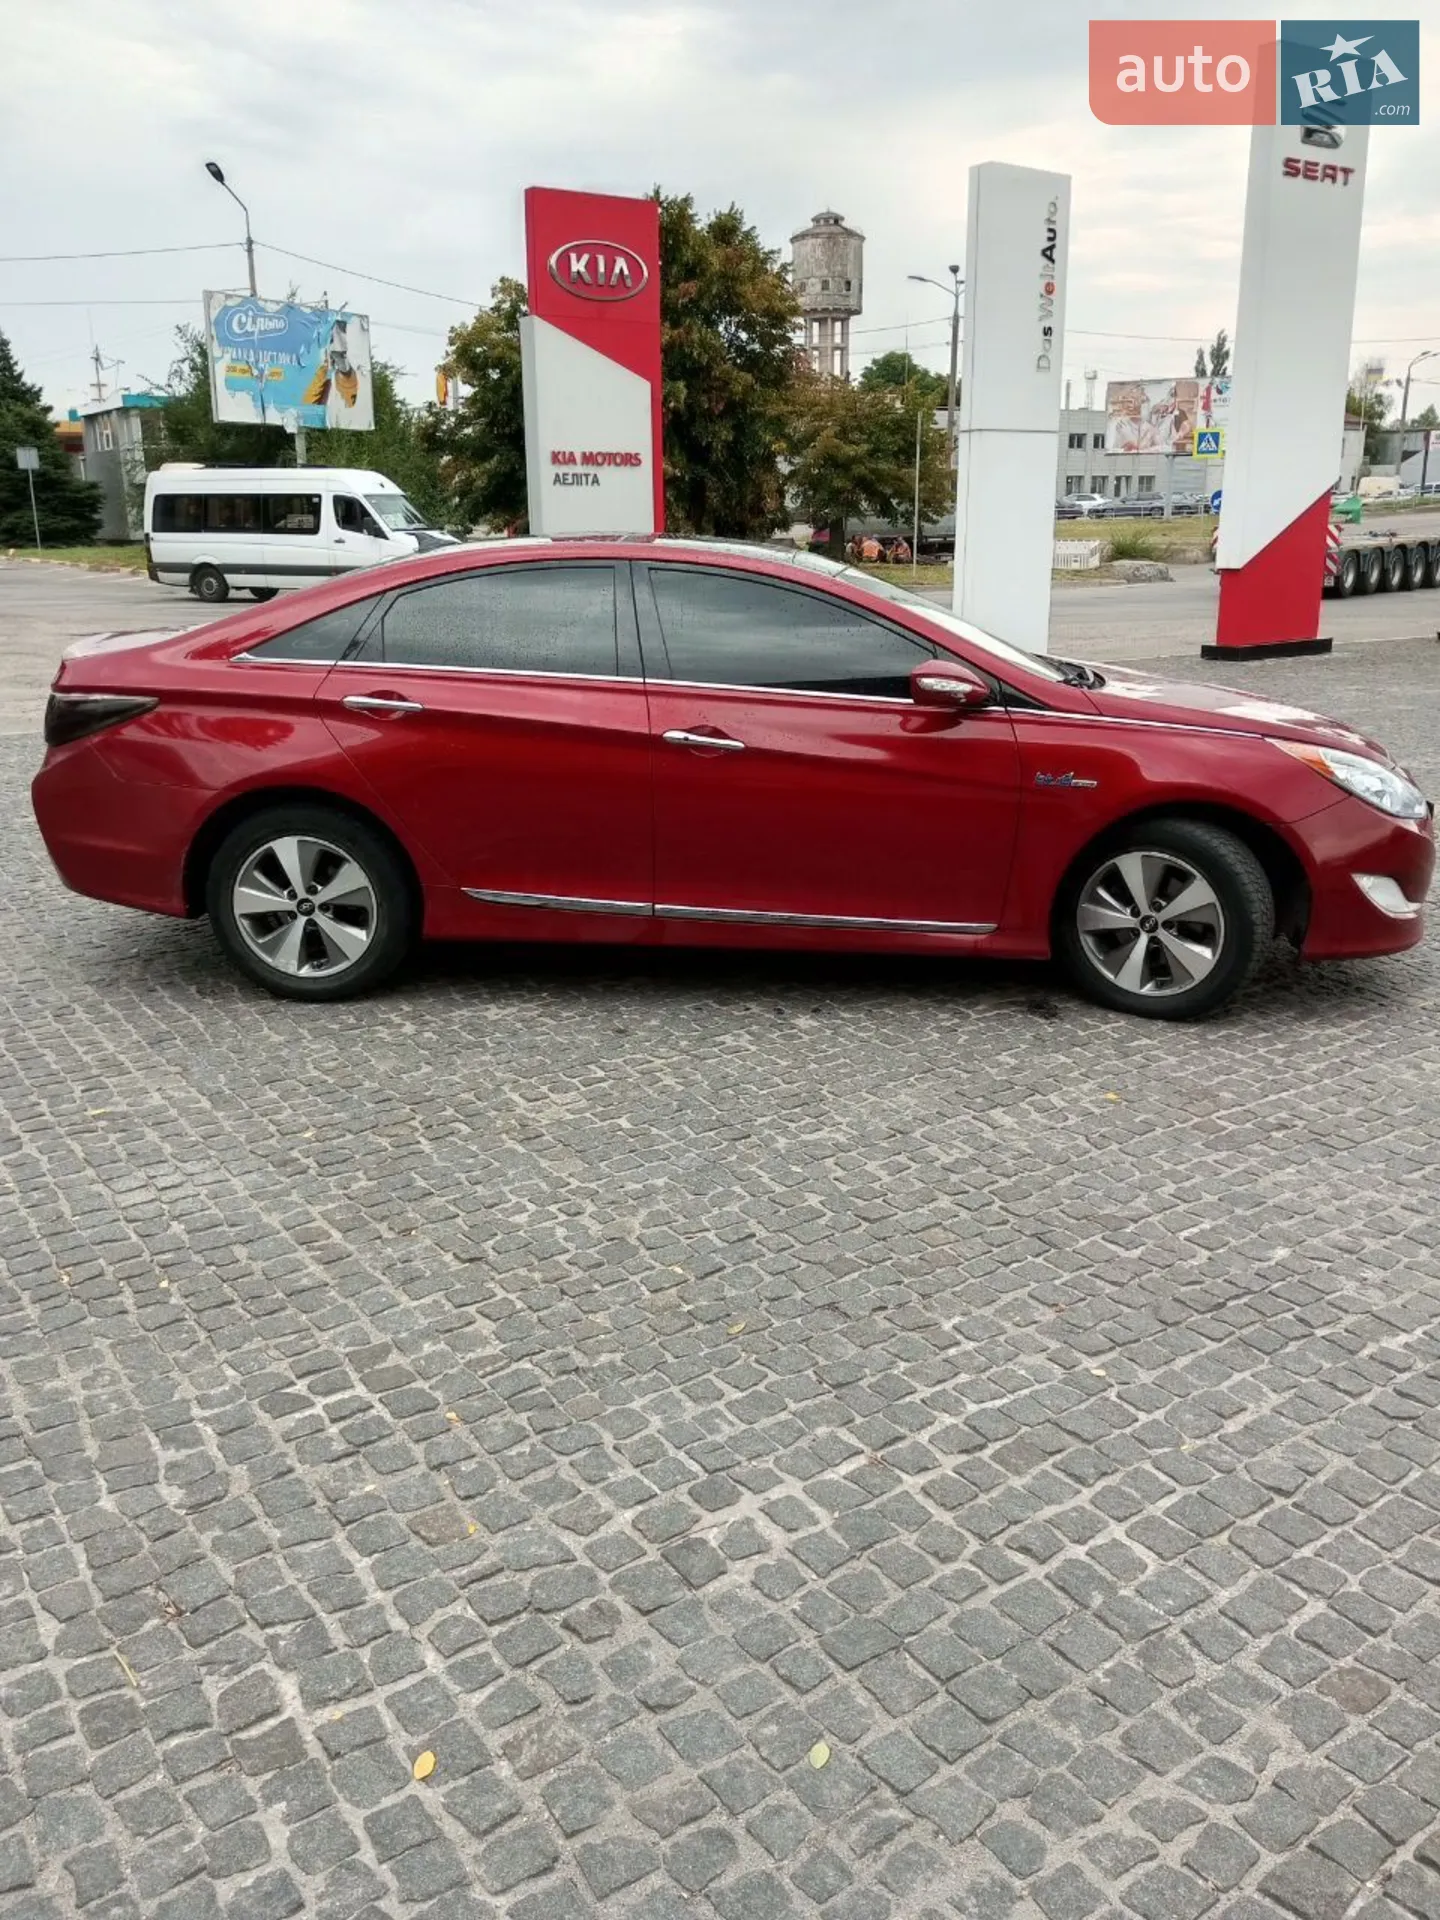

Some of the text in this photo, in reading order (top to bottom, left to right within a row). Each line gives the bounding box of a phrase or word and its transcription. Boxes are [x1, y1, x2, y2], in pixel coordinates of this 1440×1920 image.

[1282, 157, 1356, 187] SEAT
[568, 252, 632, 288] KIA
[1036, 326, 1053, 372] Das
[551, 451, 643, 467] KIA MOTORS
[552, 472, 601, 487] АЕЛІТА
